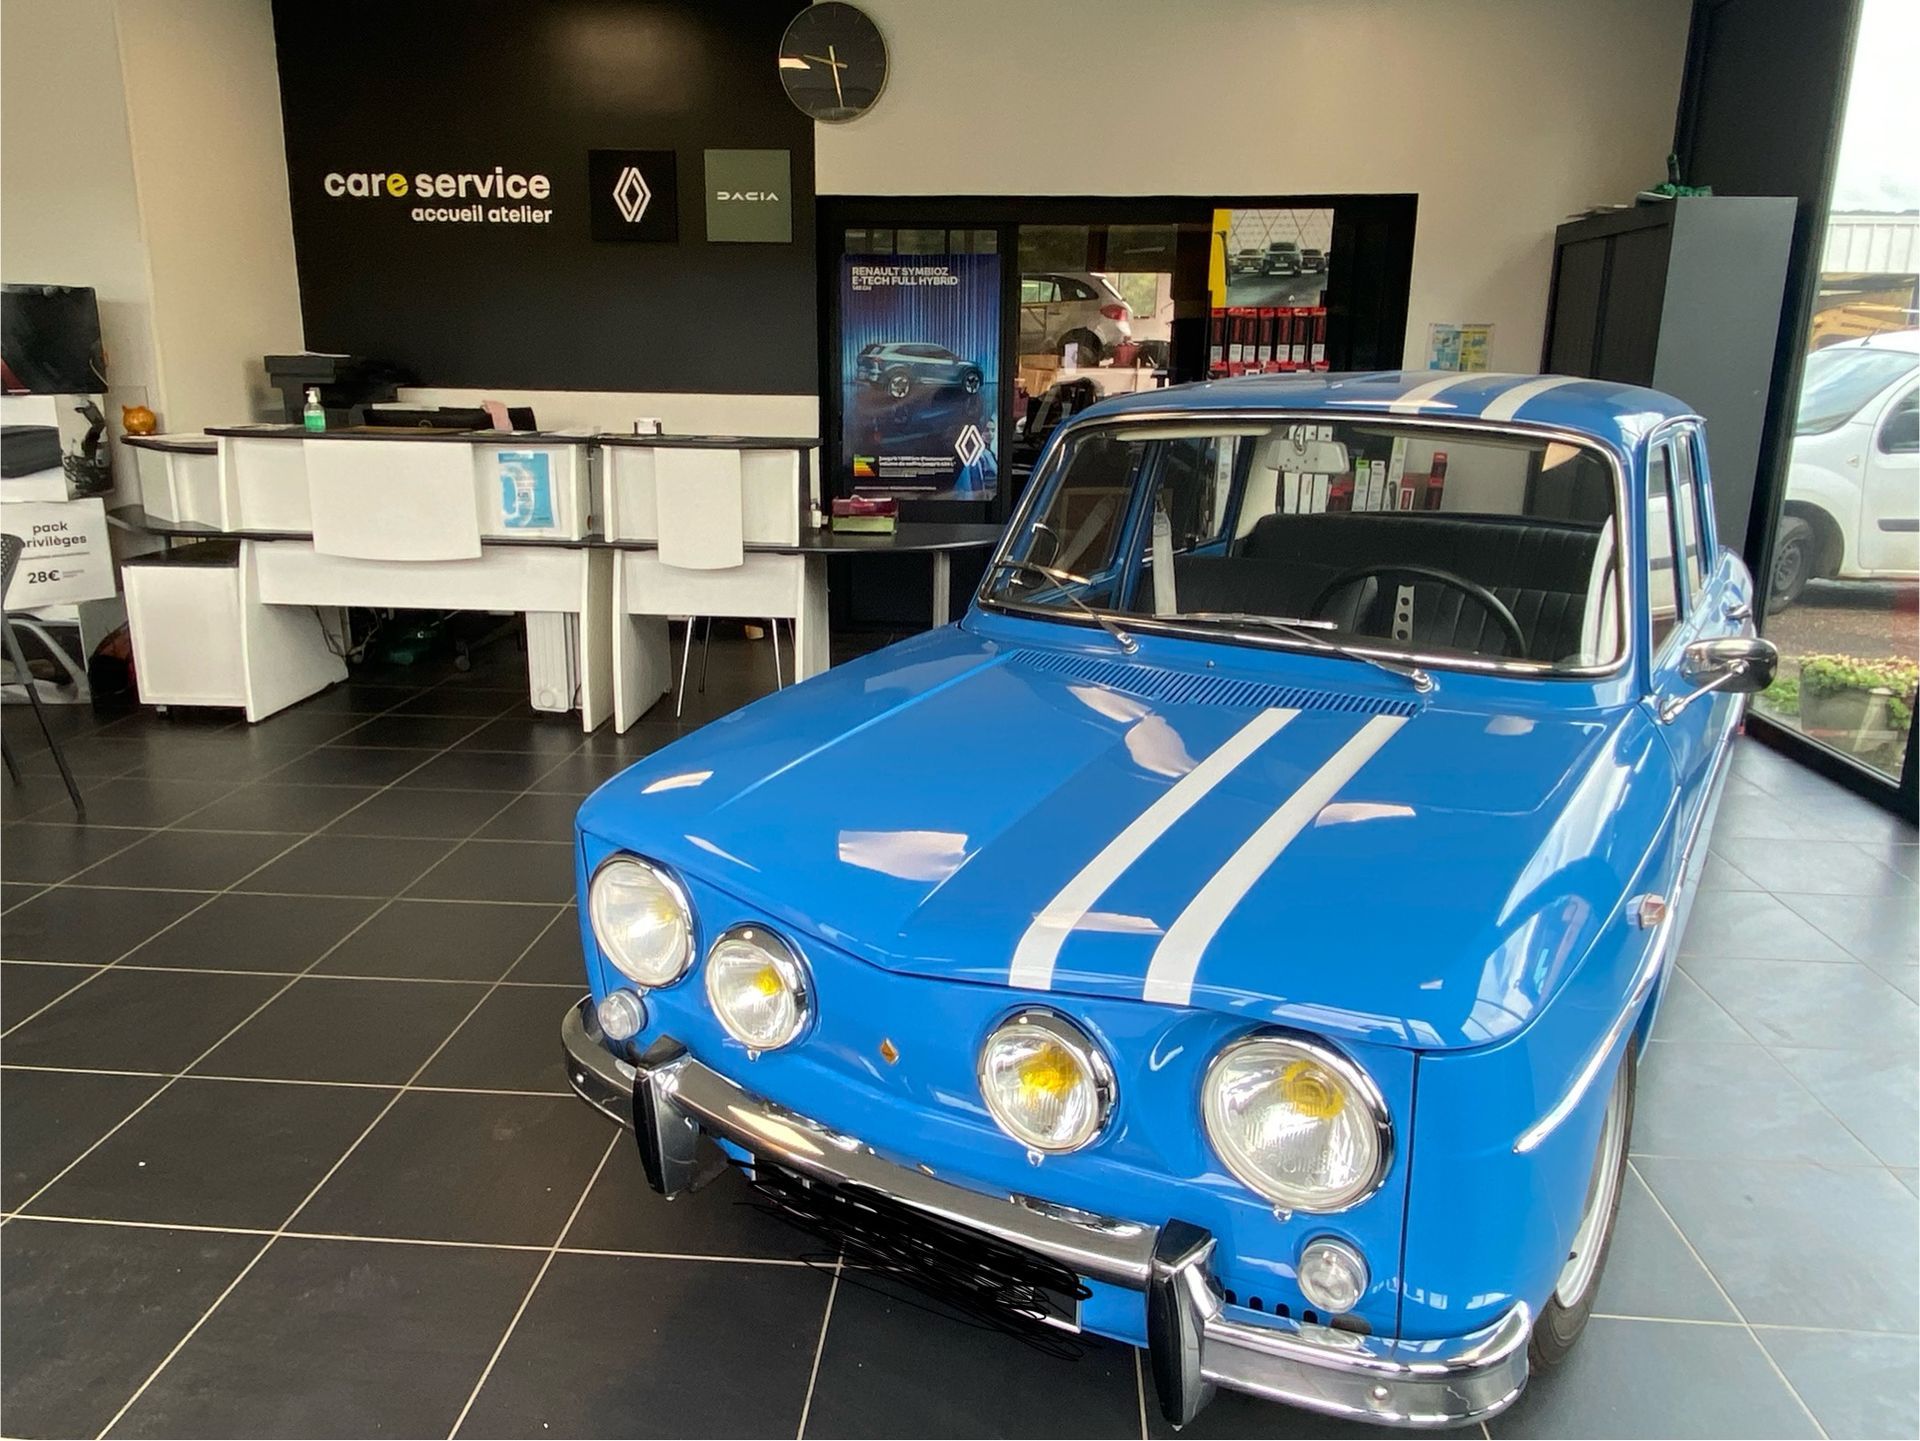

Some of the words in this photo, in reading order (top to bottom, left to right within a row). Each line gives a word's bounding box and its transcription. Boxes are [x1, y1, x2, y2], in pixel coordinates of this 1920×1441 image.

[324, 172, 409, 198] care
[415, 166, 551, 199] service
[717, 191, 779, 202] DACIA
[411, 204, 484, 222] accueil
[487, 205, 553, 223] atelier
[852, 266, 900, 276] RENAULT
[901, 266, 949, 276] SYMBIOZ
[852, 276, 890, 286] E-TECH
[892, 276, 918, 286] FULL
[918, 276, 959, 286] HYBRID
[32, 521, 69, 536] pack
[23, 535, 88, 549] rivilèges
[27, 569, 61, 585] 28€
